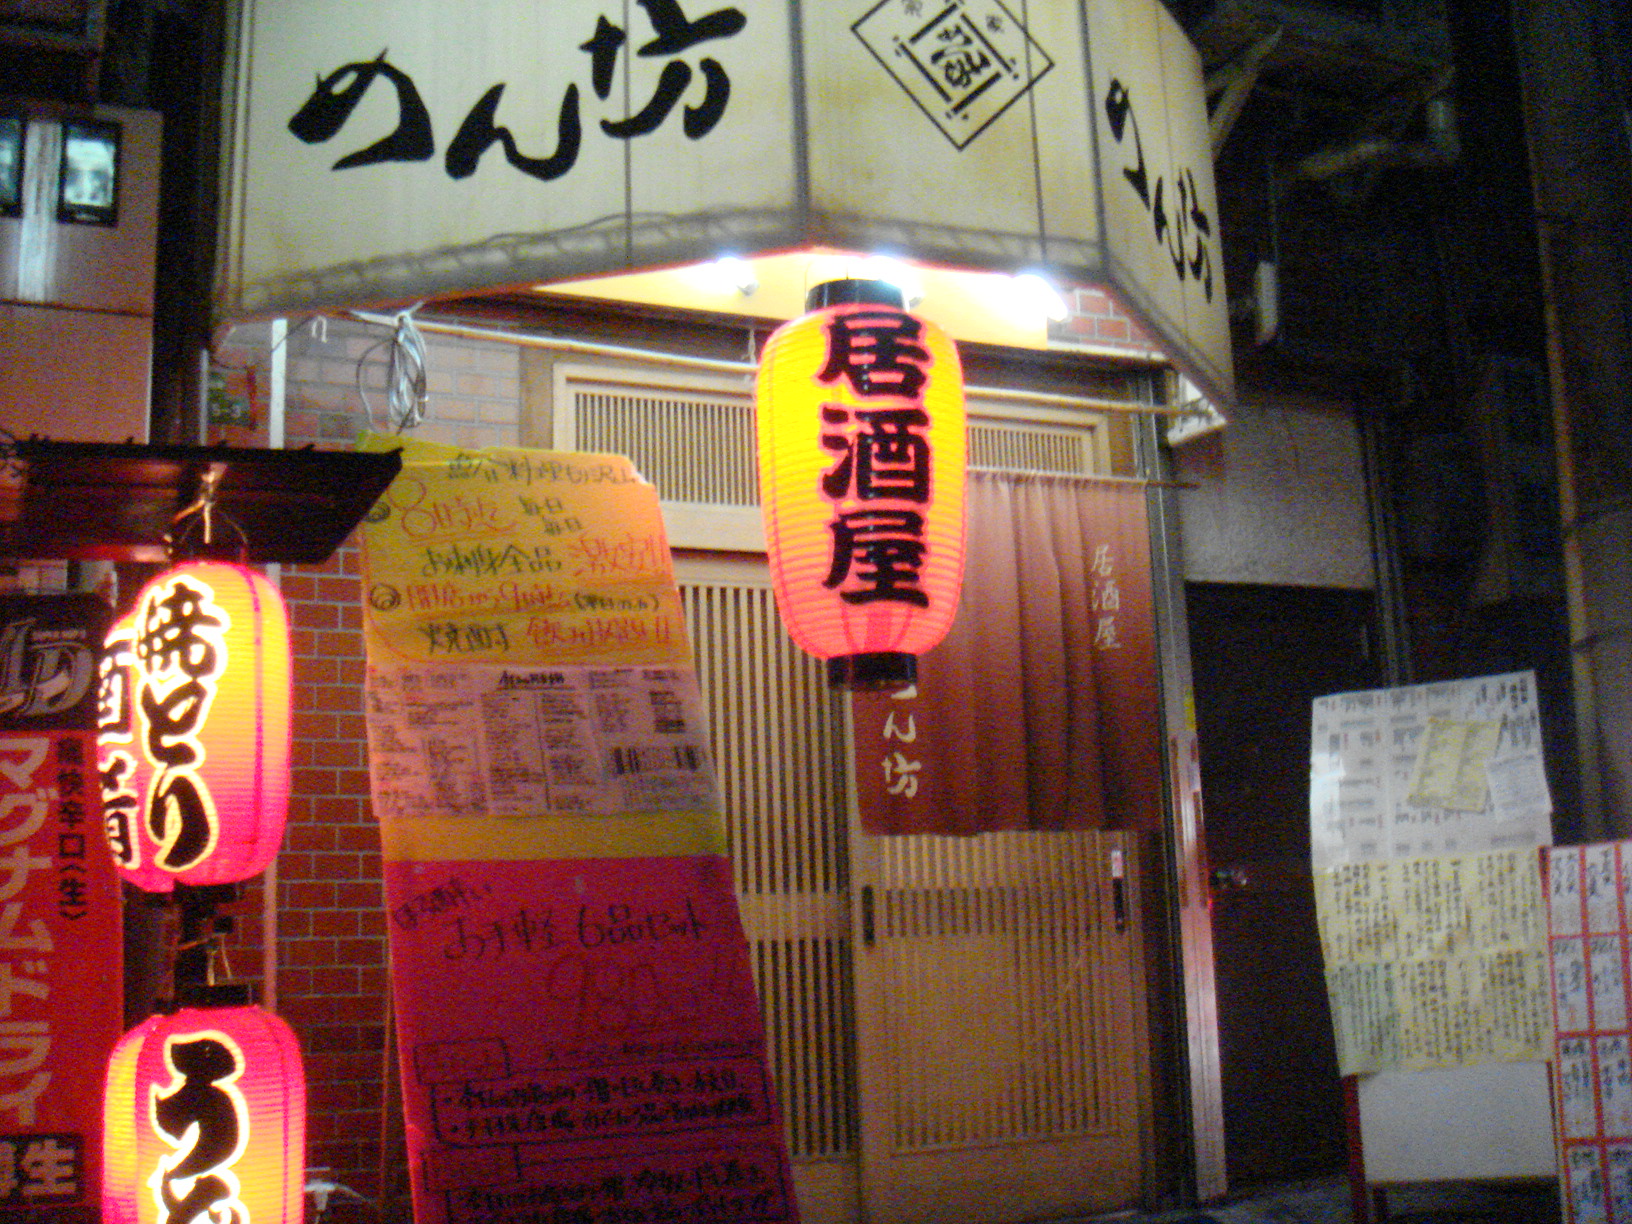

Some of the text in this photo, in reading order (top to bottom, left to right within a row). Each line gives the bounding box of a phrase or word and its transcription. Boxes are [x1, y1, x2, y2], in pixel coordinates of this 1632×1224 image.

[288, 0, 747, 181] のん坊
[818, 311, 930, 609] 居酒屋
[1090, 544, 1121, 650] 居酒屋
[881, 684, 922, 799] ん坊
